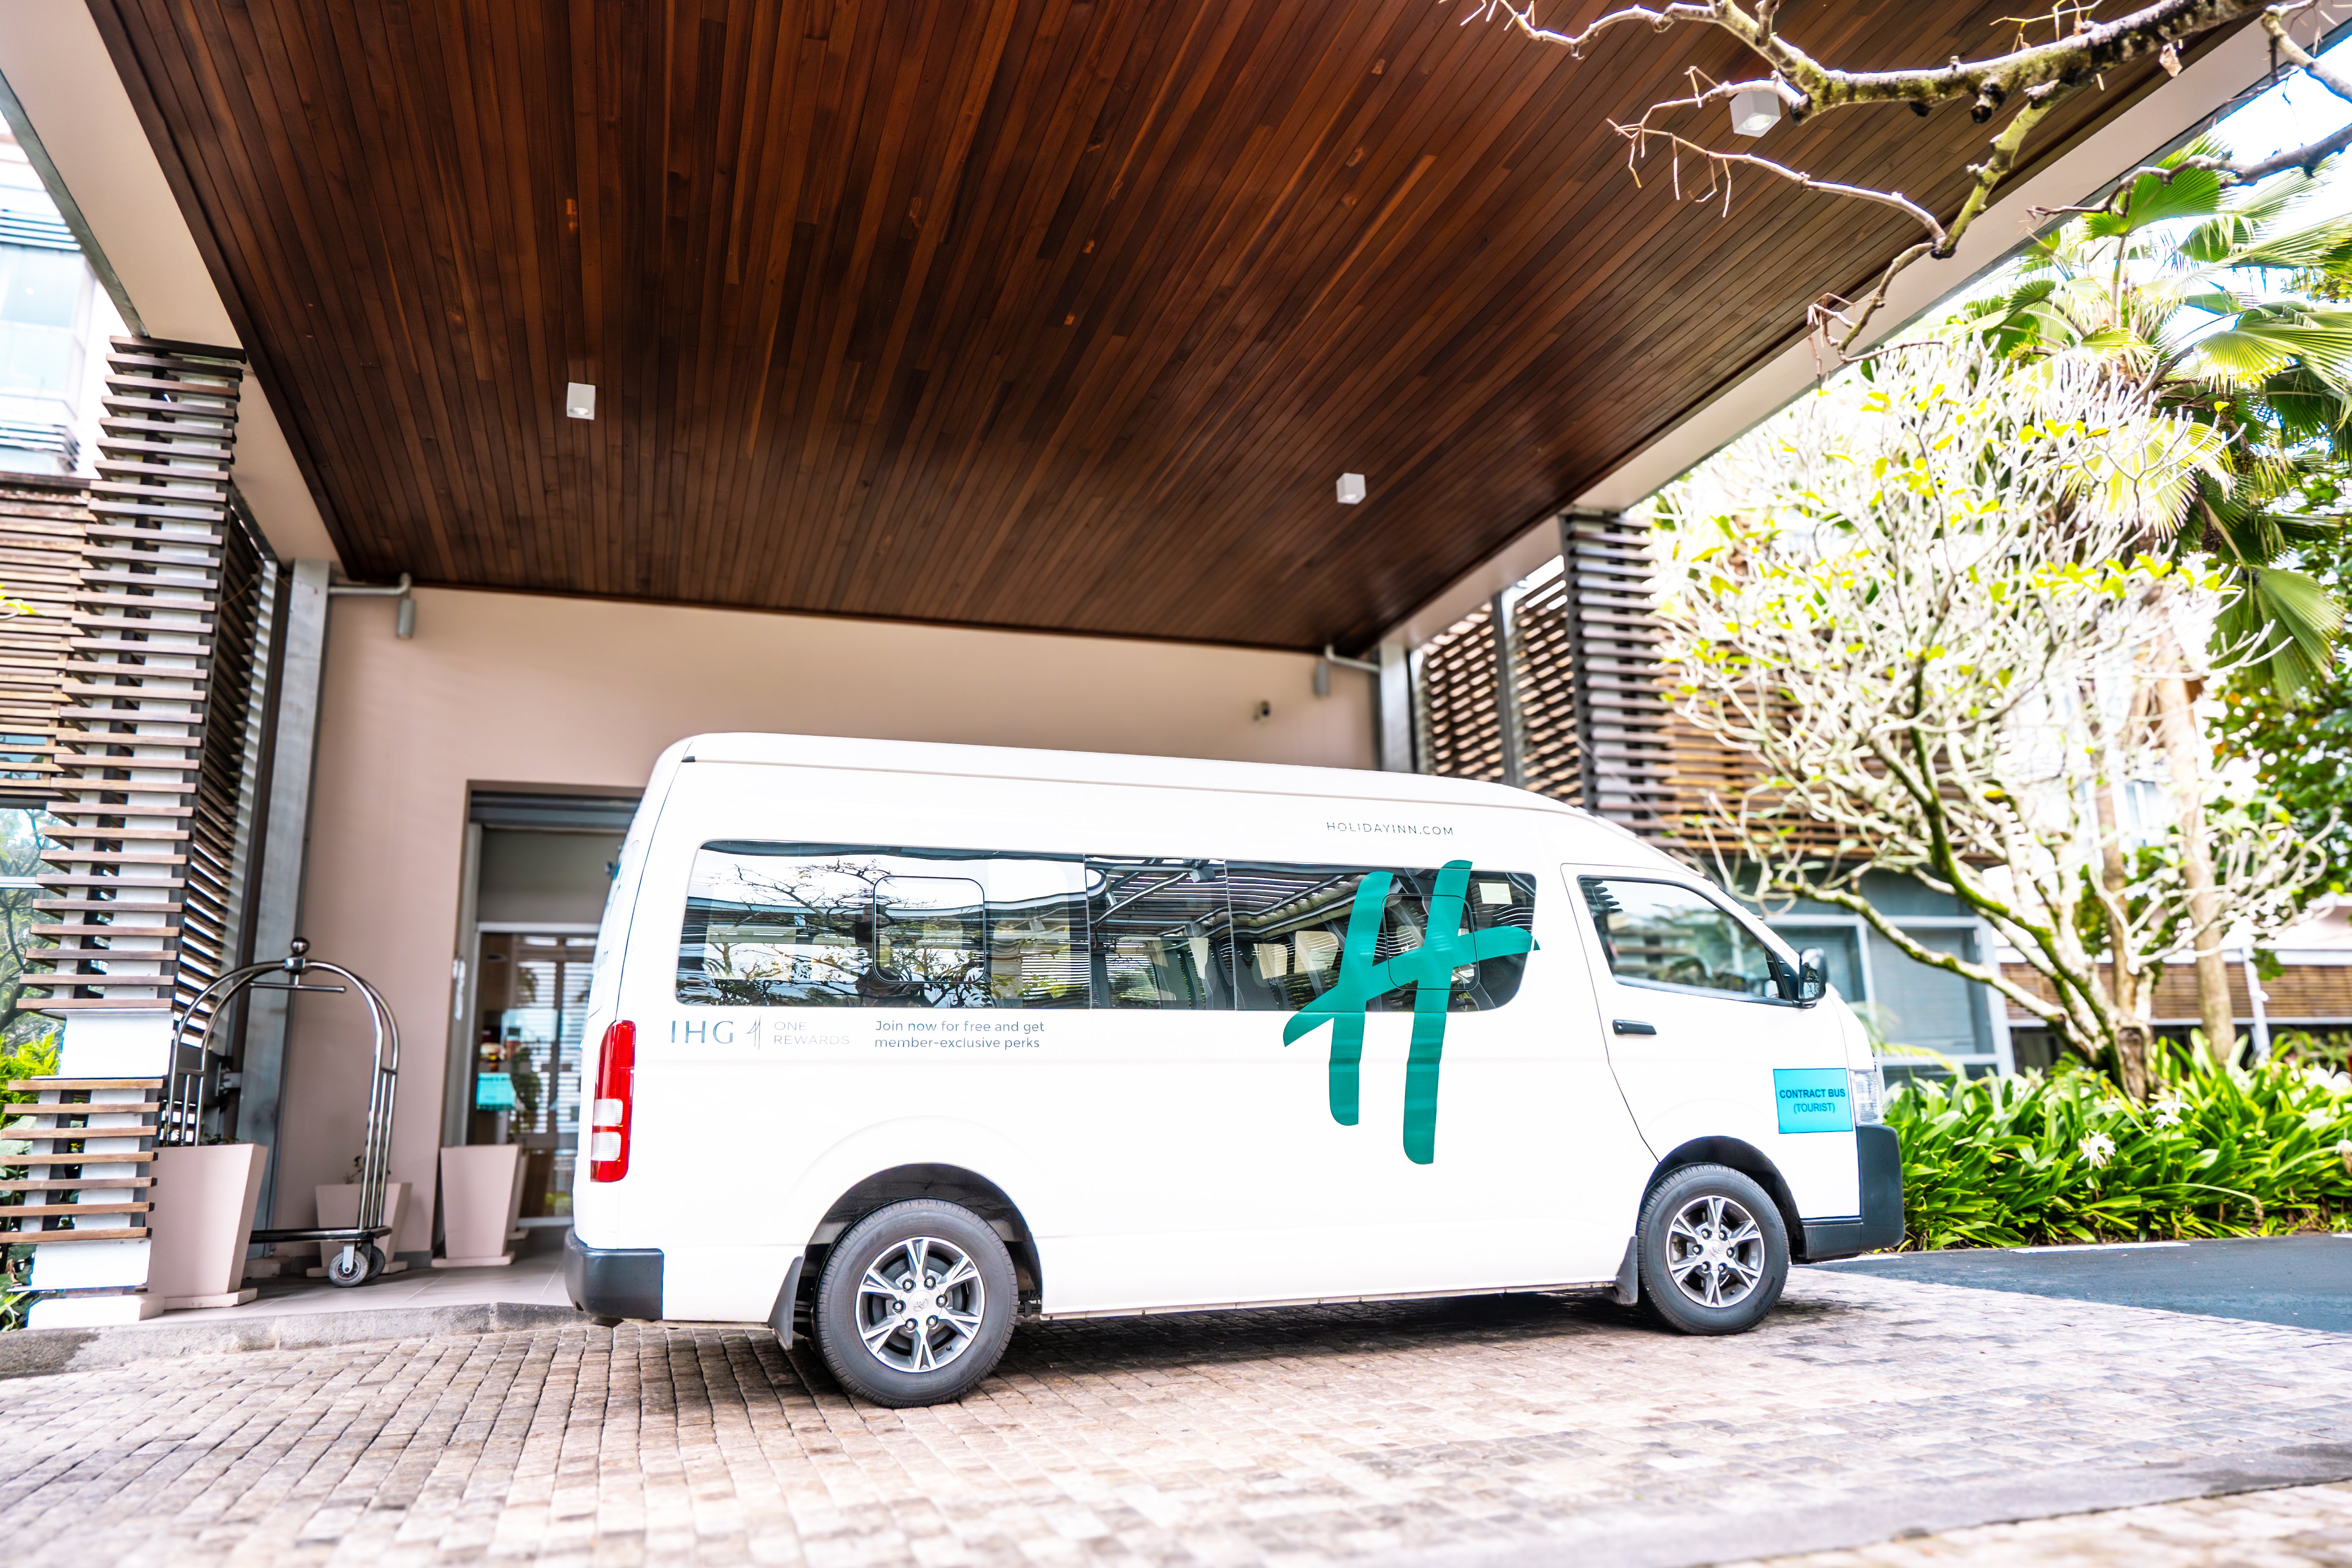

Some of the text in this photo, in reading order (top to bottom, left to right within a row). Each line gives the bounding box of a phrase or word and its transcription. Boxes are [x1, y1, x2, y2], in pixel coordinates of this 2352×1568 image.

[1326, 822, 1453, 835] HOLIDAYINN.COM
[774, 1021, 807, 1030] ONE
[875, 1020, 1045, 1034] Join now for free and get
[671, 1020, 734, 1044] IHG
[774, 1035, 849, 1045] REWARDS
[875, 1037, 1040, 1050] member-exclusive perks
[1780, 1089, 1845, 1098] CONTRACT BUS
[1793, 1103, 1835, 1114] (TOURIST)
